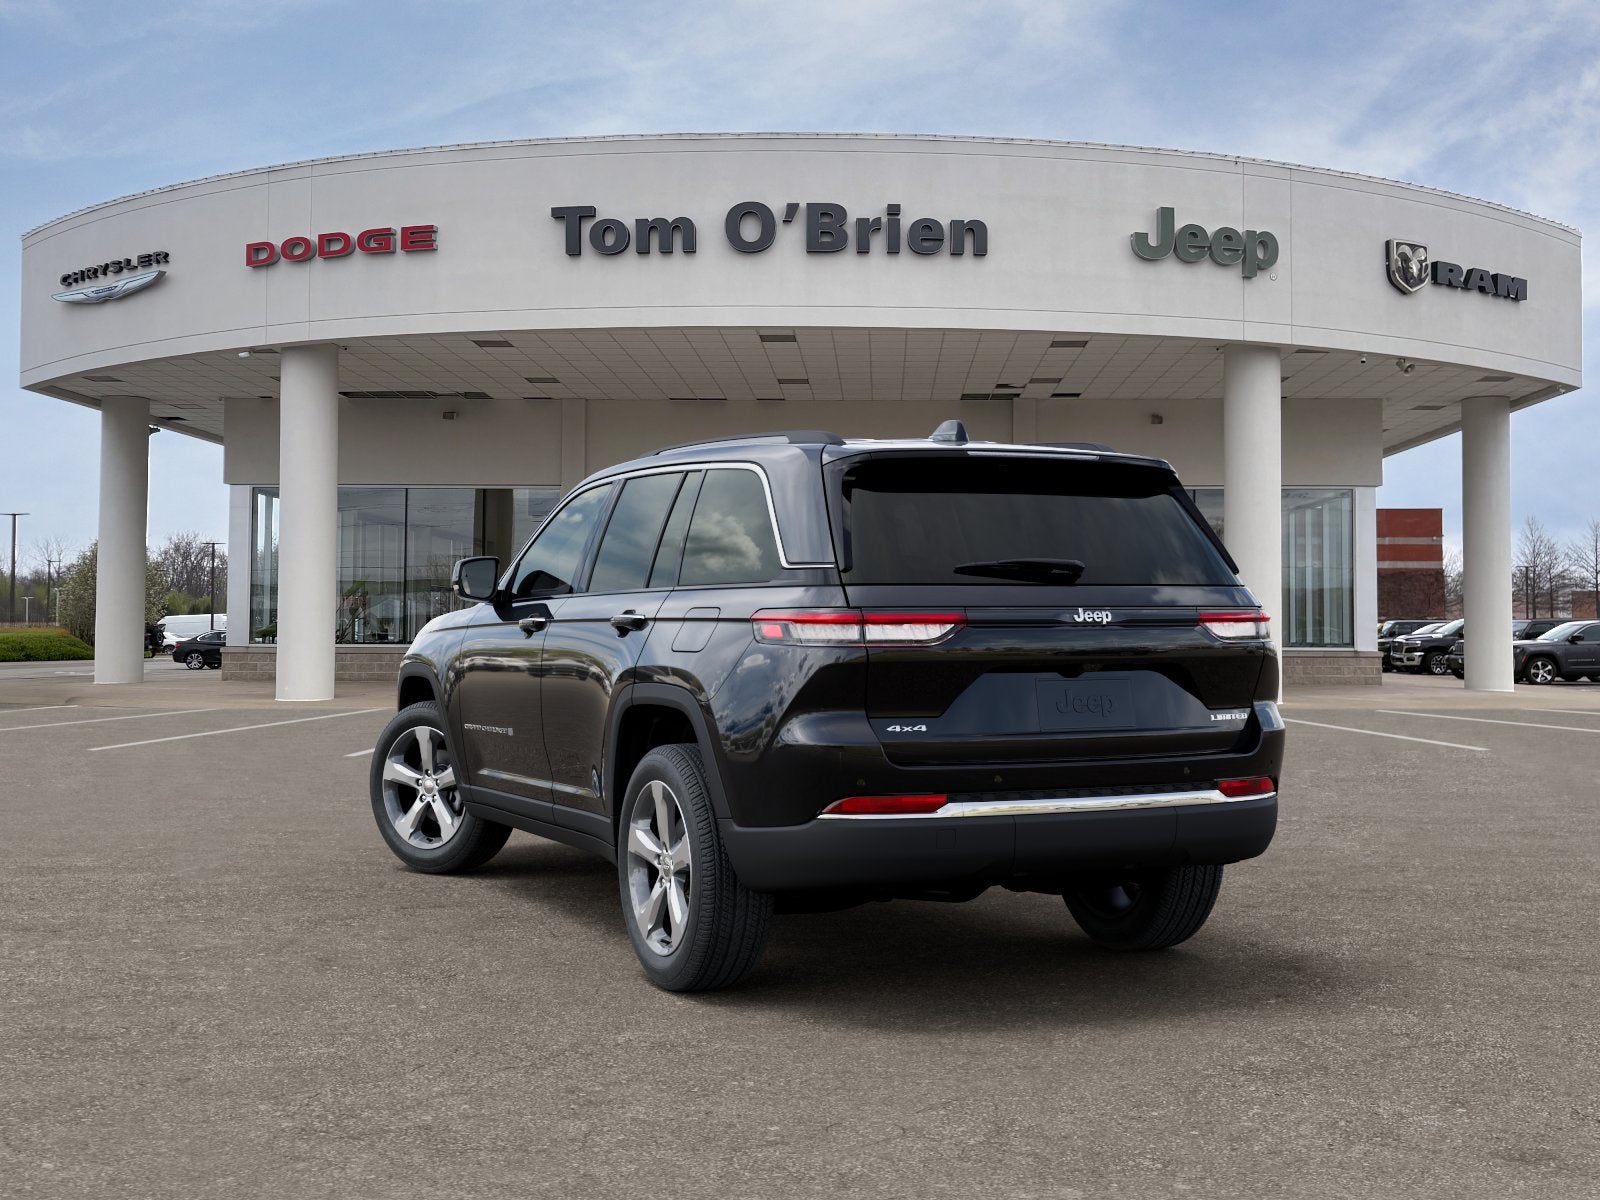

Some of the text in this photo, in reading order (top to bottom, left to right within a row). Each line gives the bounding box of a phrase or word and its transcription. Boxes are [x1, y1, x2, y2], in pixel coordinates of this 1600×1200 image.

[245, 224, 439, 269] DODGE
[551, 200, 989, 257] Tom O'Brien
[1130, 206, 1280, 280] Jeep
[59, 250, 170, 287] CHRYSLER
[1431, 260, 1528, 302] RAM
[1073, 607, 1112, 625] Jeep
[1056, 688, 1114, 718] Jeep
[886, 724, 927, 732] 4x4
